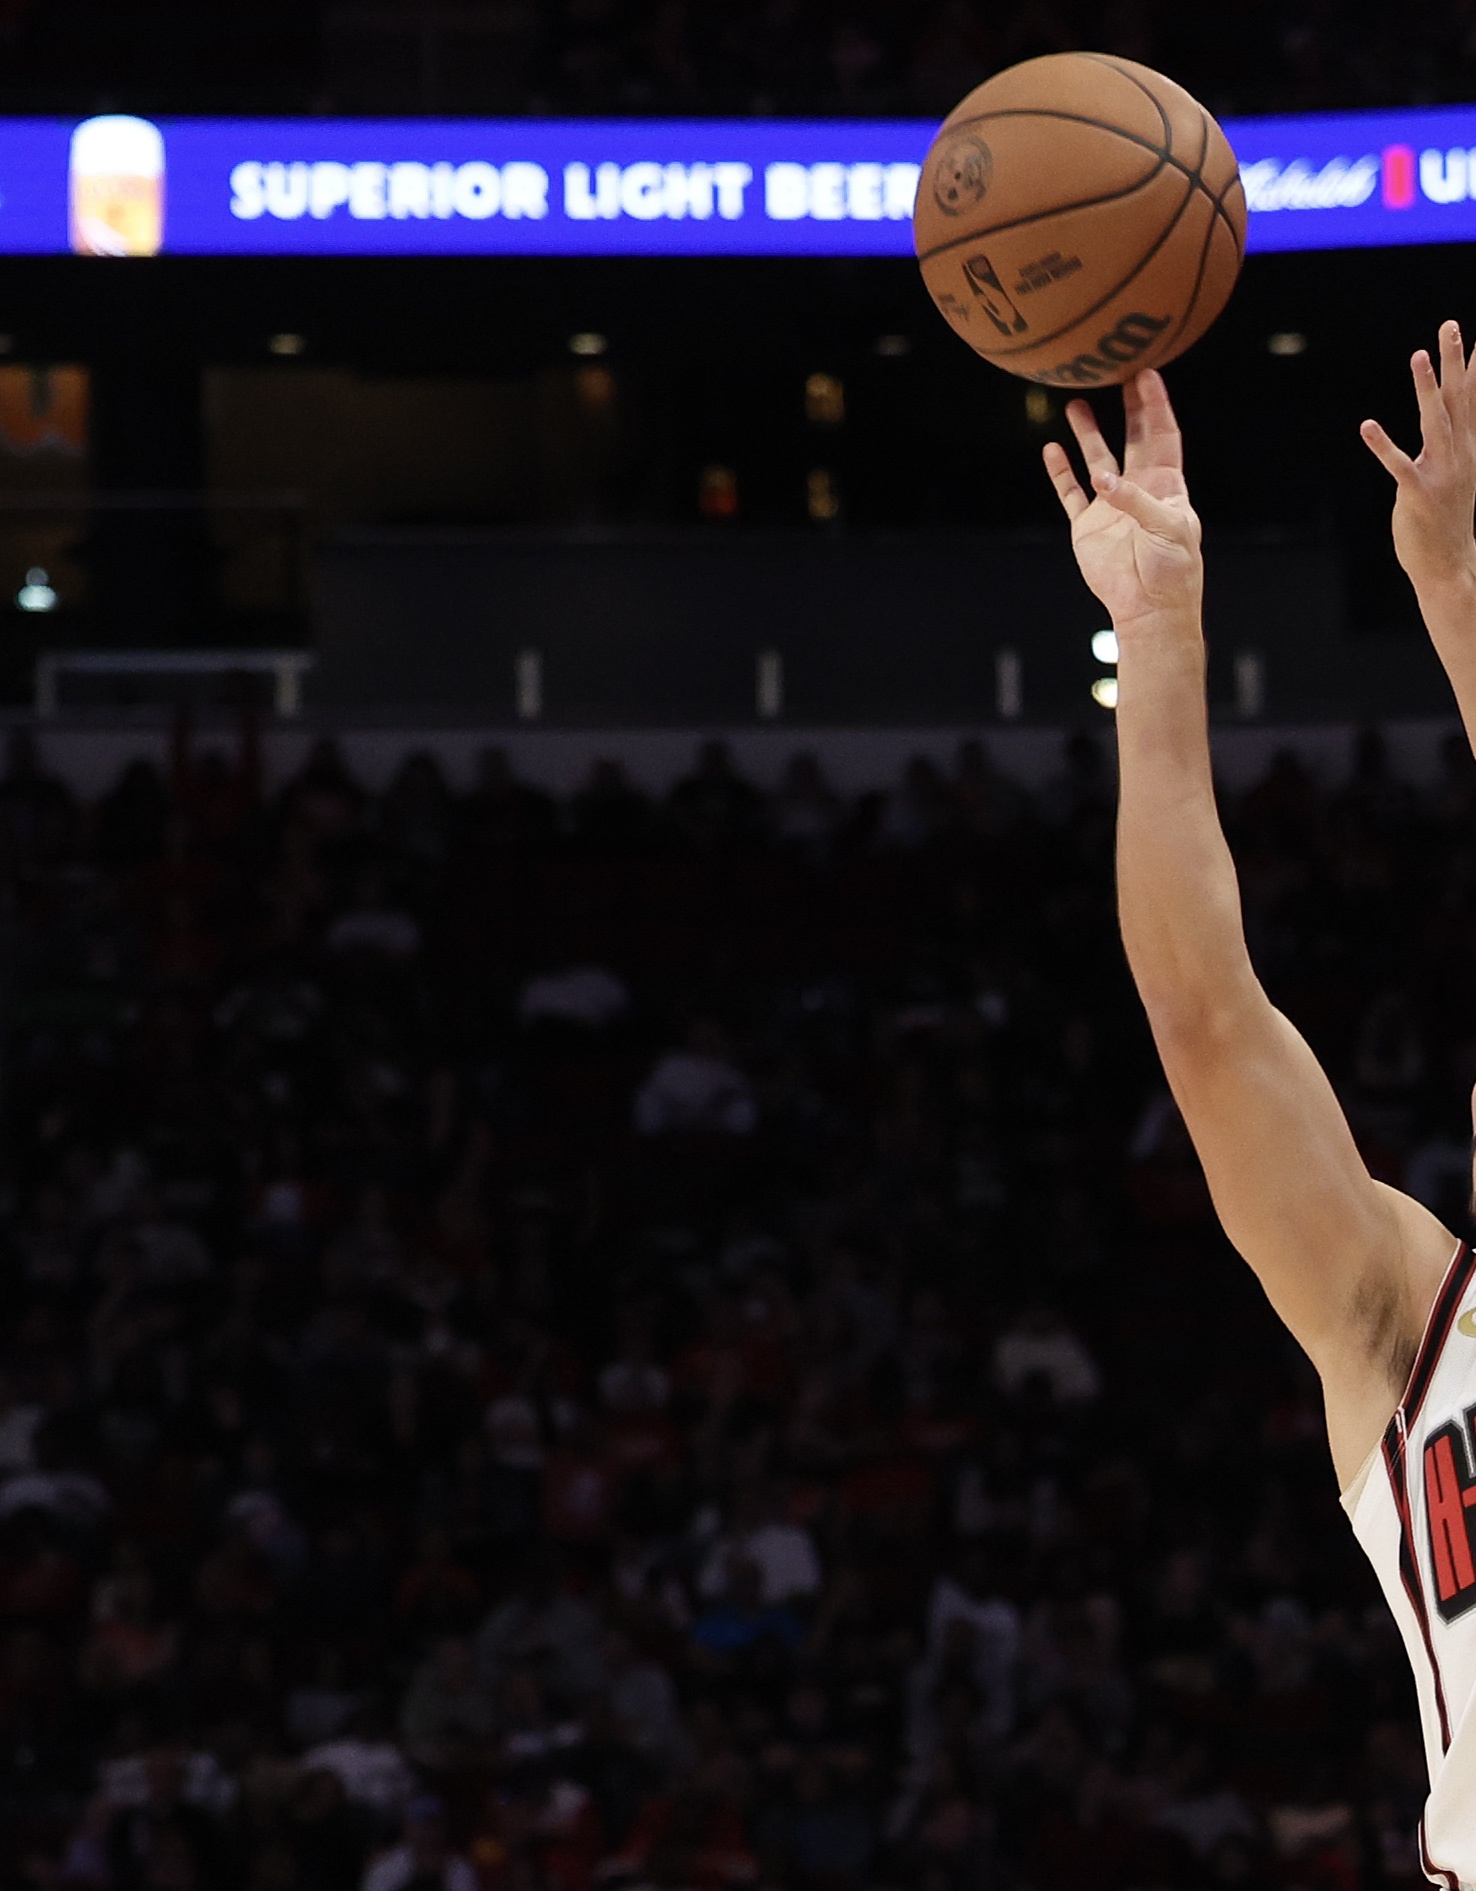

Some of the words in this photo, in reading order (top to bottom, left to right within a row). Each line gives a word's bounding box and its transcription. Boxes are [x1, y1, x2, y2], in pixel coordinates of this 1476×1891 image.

[229, 159, 549, 220] SUPERIOR
[563, 161, 753, 220] LIGHT
[764, 161, 921, 221] BEER
